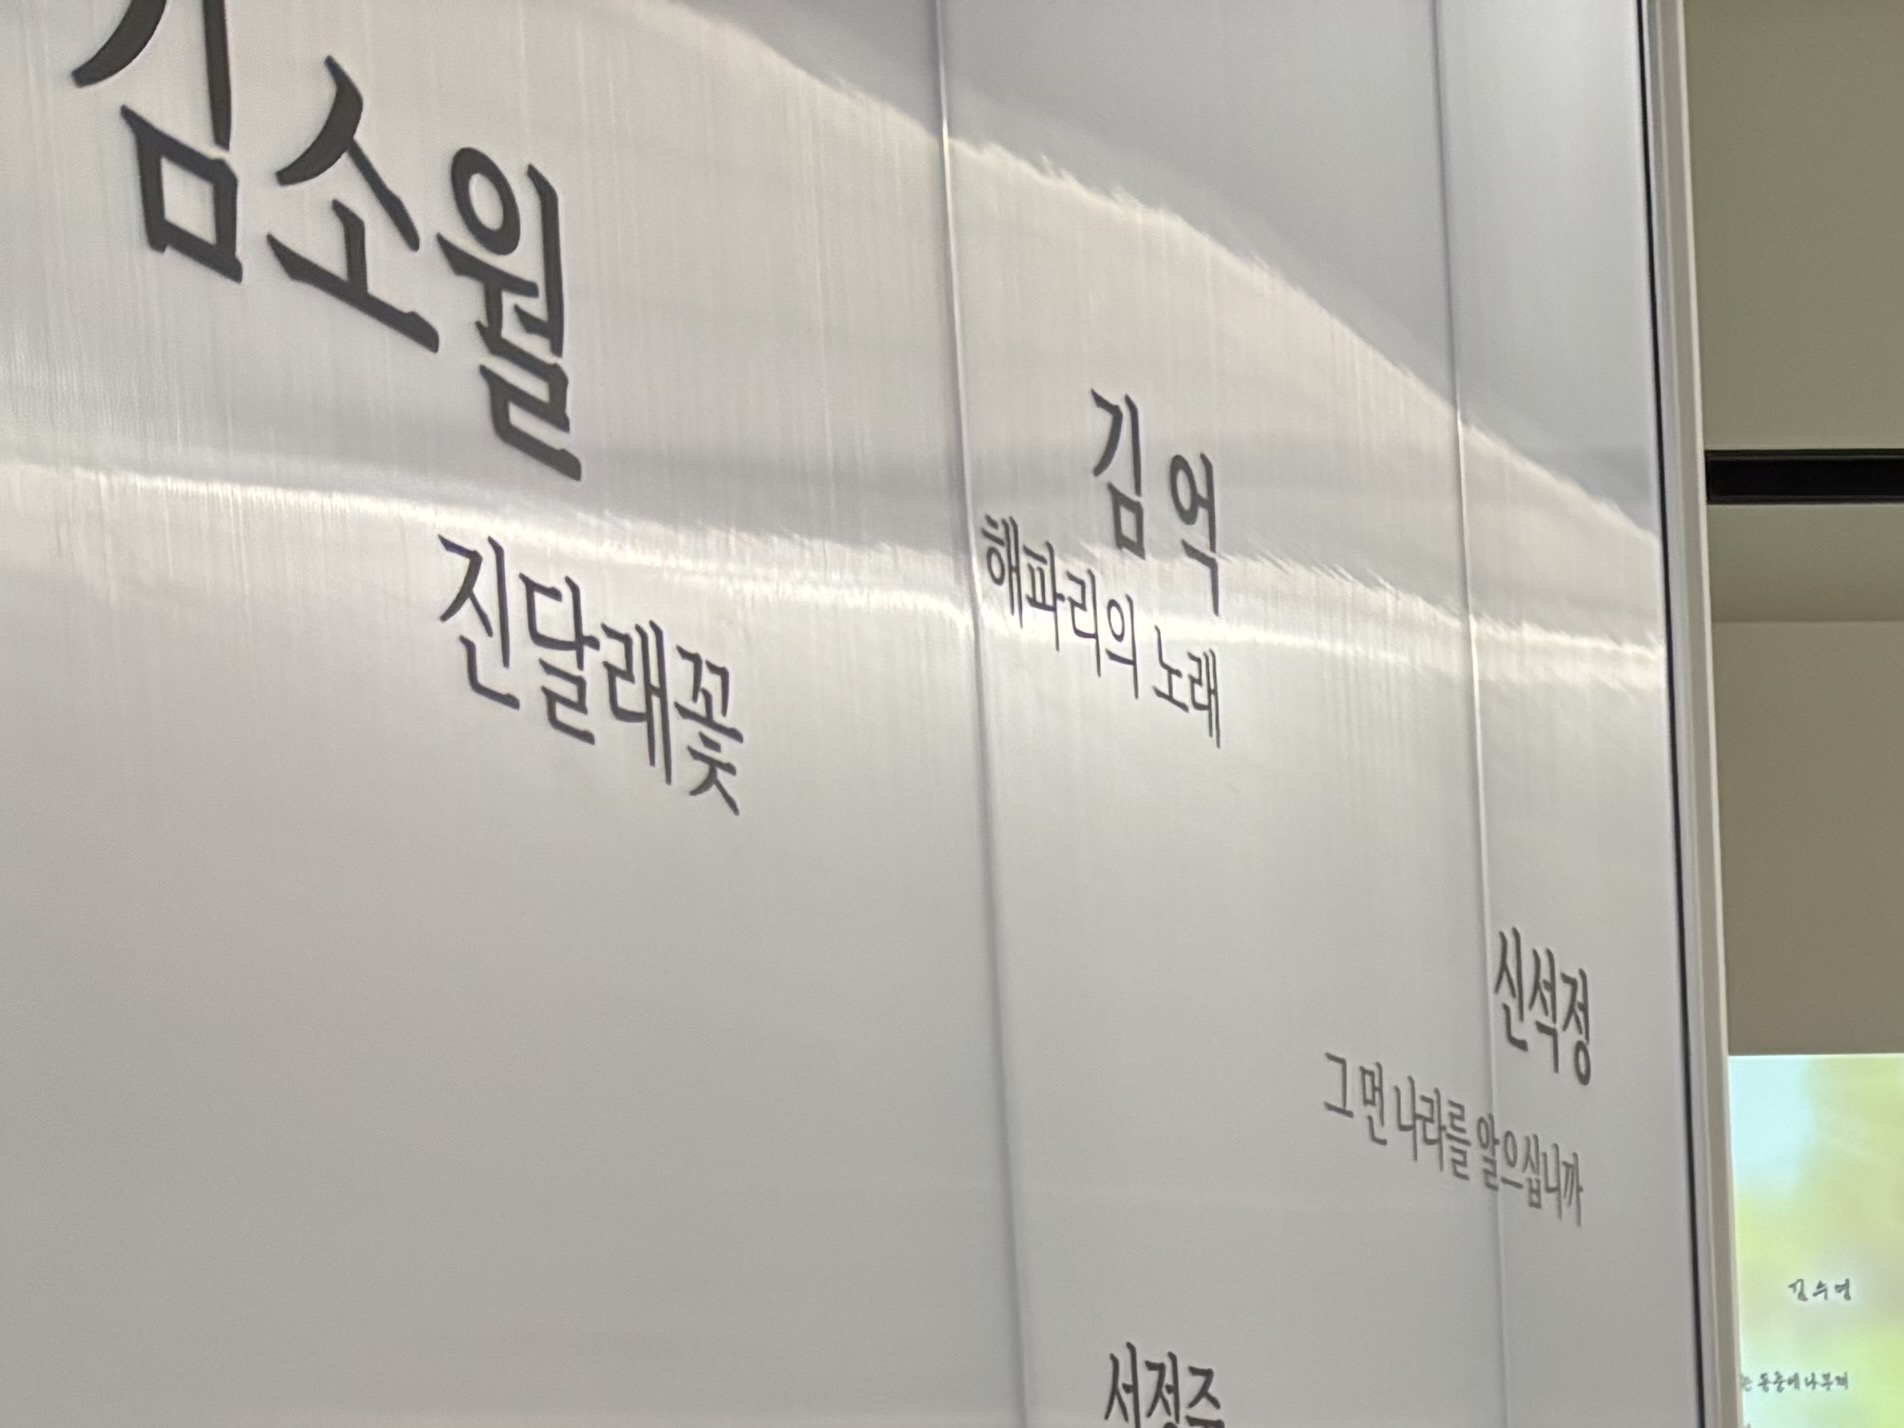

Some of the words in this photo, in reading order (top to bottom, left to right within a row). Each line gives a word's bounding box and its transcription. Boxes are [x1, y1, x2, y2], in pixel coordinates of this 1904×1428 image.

[71, 0, 583, 482] 김소월
[1090, 388, 1146, 559] 김
[1169, 452, 1219, 616] 억
[437, 533, 744, 816] 진달래꽃
[980, 513, 1139, 700] 해파리의
[1153, 624, 1221, 748] 노래
[1494, 926, 1593, 1086] 신석정
[1324, 1052, 1354, 1118] 그
[1359, 1061, 1388, 1146] 먼
[1393, 1075, 1472, 1181] 나라를
[1477, 1113, 1584, 1227] 알으십니까
